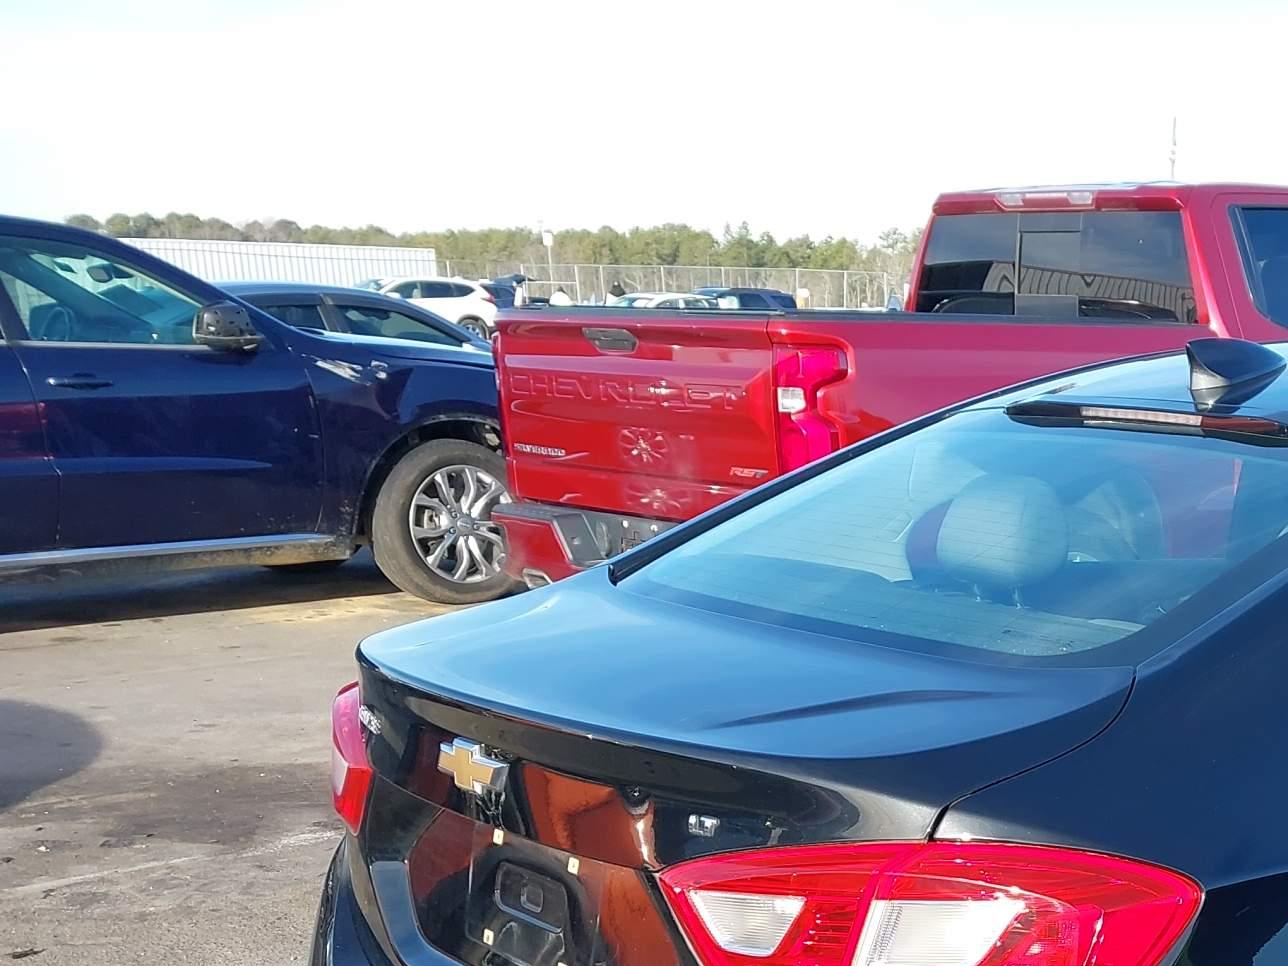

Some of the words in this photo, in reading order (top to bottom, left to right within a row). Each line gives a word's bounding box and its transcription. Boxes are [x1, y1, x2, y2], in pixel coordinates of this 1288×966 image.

[510, 373, 746, 410] CHEVROLET
[729, 466, 769, 479] RST
[687, 814, 721, 837] LT
